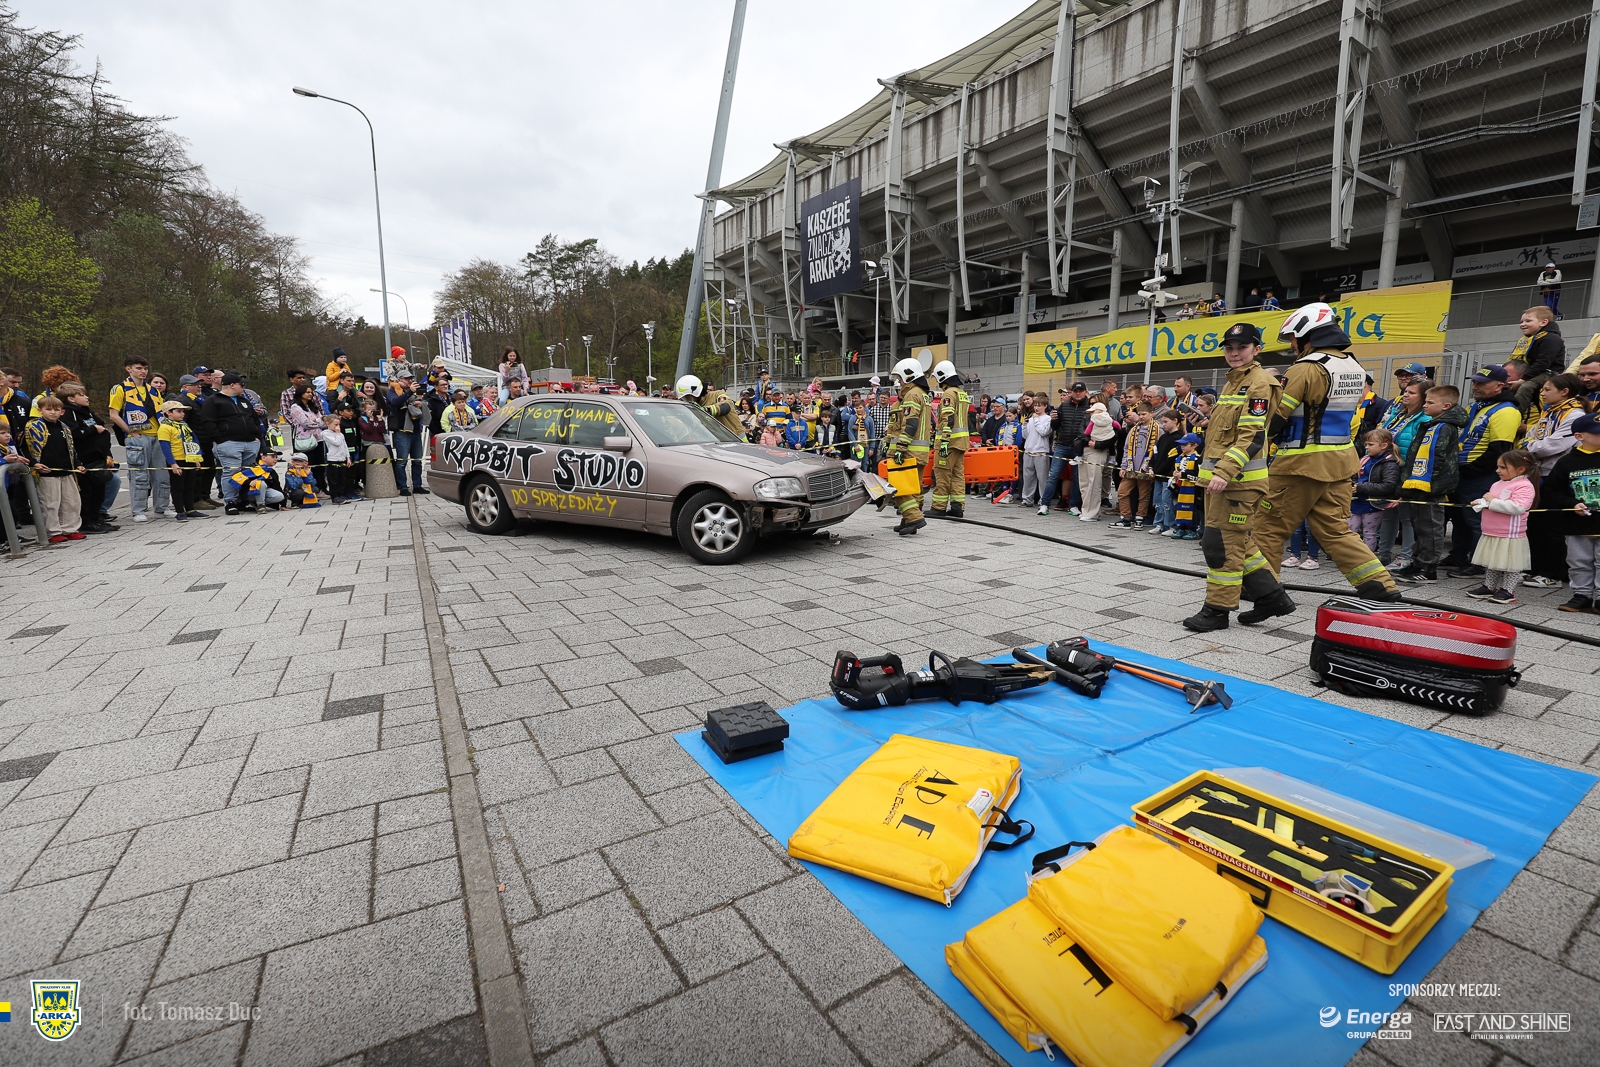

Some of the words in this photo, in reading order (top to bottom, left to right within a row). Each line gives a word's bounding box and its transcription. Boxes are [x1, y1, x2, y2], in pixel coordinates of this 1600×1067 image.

[807, 195, 851, 238] KASZËBË
[809, 256, 836, 284] ARKA
[1339, 274, 1357, 287] 22
[1044, 334, 1136, 369] Wiara
[499, 406, 617, 424] PRZYGOTOWANIE
[544, 421, 580, 438] AUT
[441, 434, 547, 485] RABBIT
[552, 447, 646, 493] STUDIO
[511, 488, 528, 505] DO
[531, 488, 618, 518] SPRZEDAŻY
[1187, 837, 1274, 882] GLASMANAGEMENT
